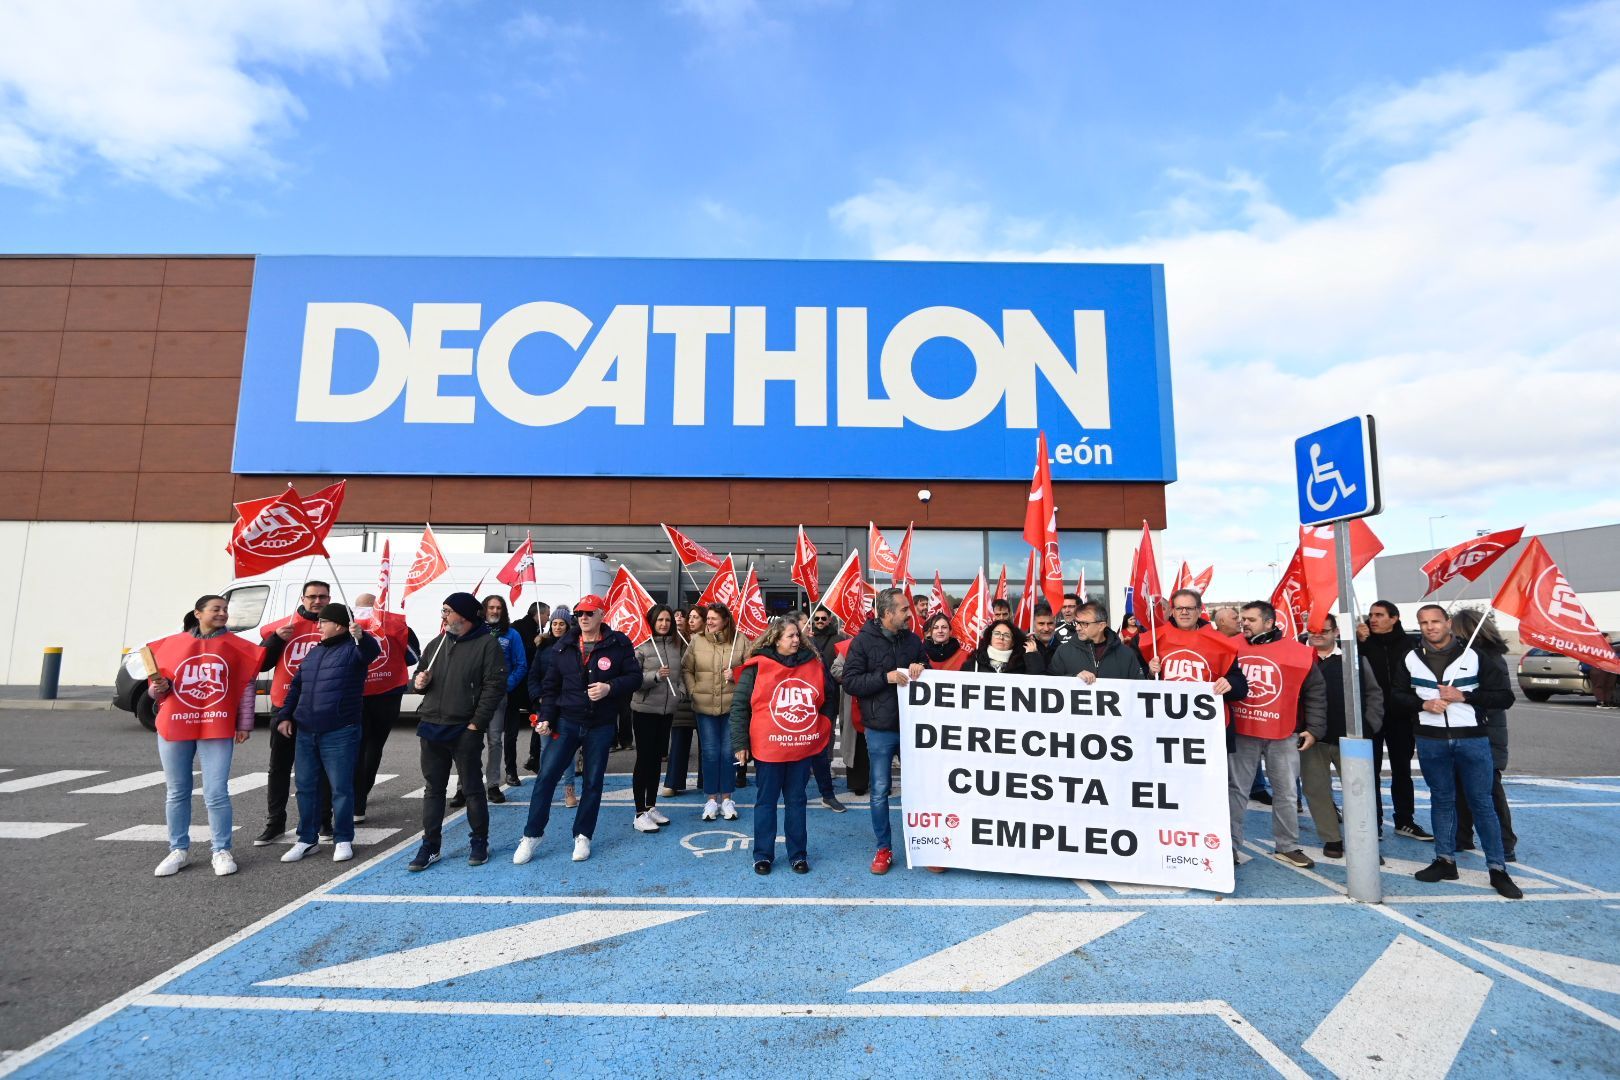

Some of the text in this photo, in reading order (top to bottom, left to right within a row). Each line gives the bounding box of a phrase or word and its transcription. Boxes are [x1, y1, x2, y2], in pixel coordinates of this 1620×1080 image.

[296, 301, 1111, 431] DECATHLON
[291, 641, 320, 661] UG
[182, 663, 223, 685] UGT
[1164, 659, 1205, 681] UGT
[776, 686, 814, 707] UGT
[909, 681, 1217, 720] DEFENDER TUS
[171, 712, 200, 721] mano
[204, 710, 228, 718] mano
[1253, 709, 1280, 720] mano
[769, 734, 793, 742] mano
[915, 724, 1207, 765] DERECHOS TE
[948, 767, 1179, 810] CUESTA EL
[907, 812, 942, 828] UGT
[911, 836, 940, 845] FeSMC
[971, 818, 1138, 857] EMPLEO
[1159, 829, 1200, 848] UGT
[1166, 855, 1199, 866] FeSMC
